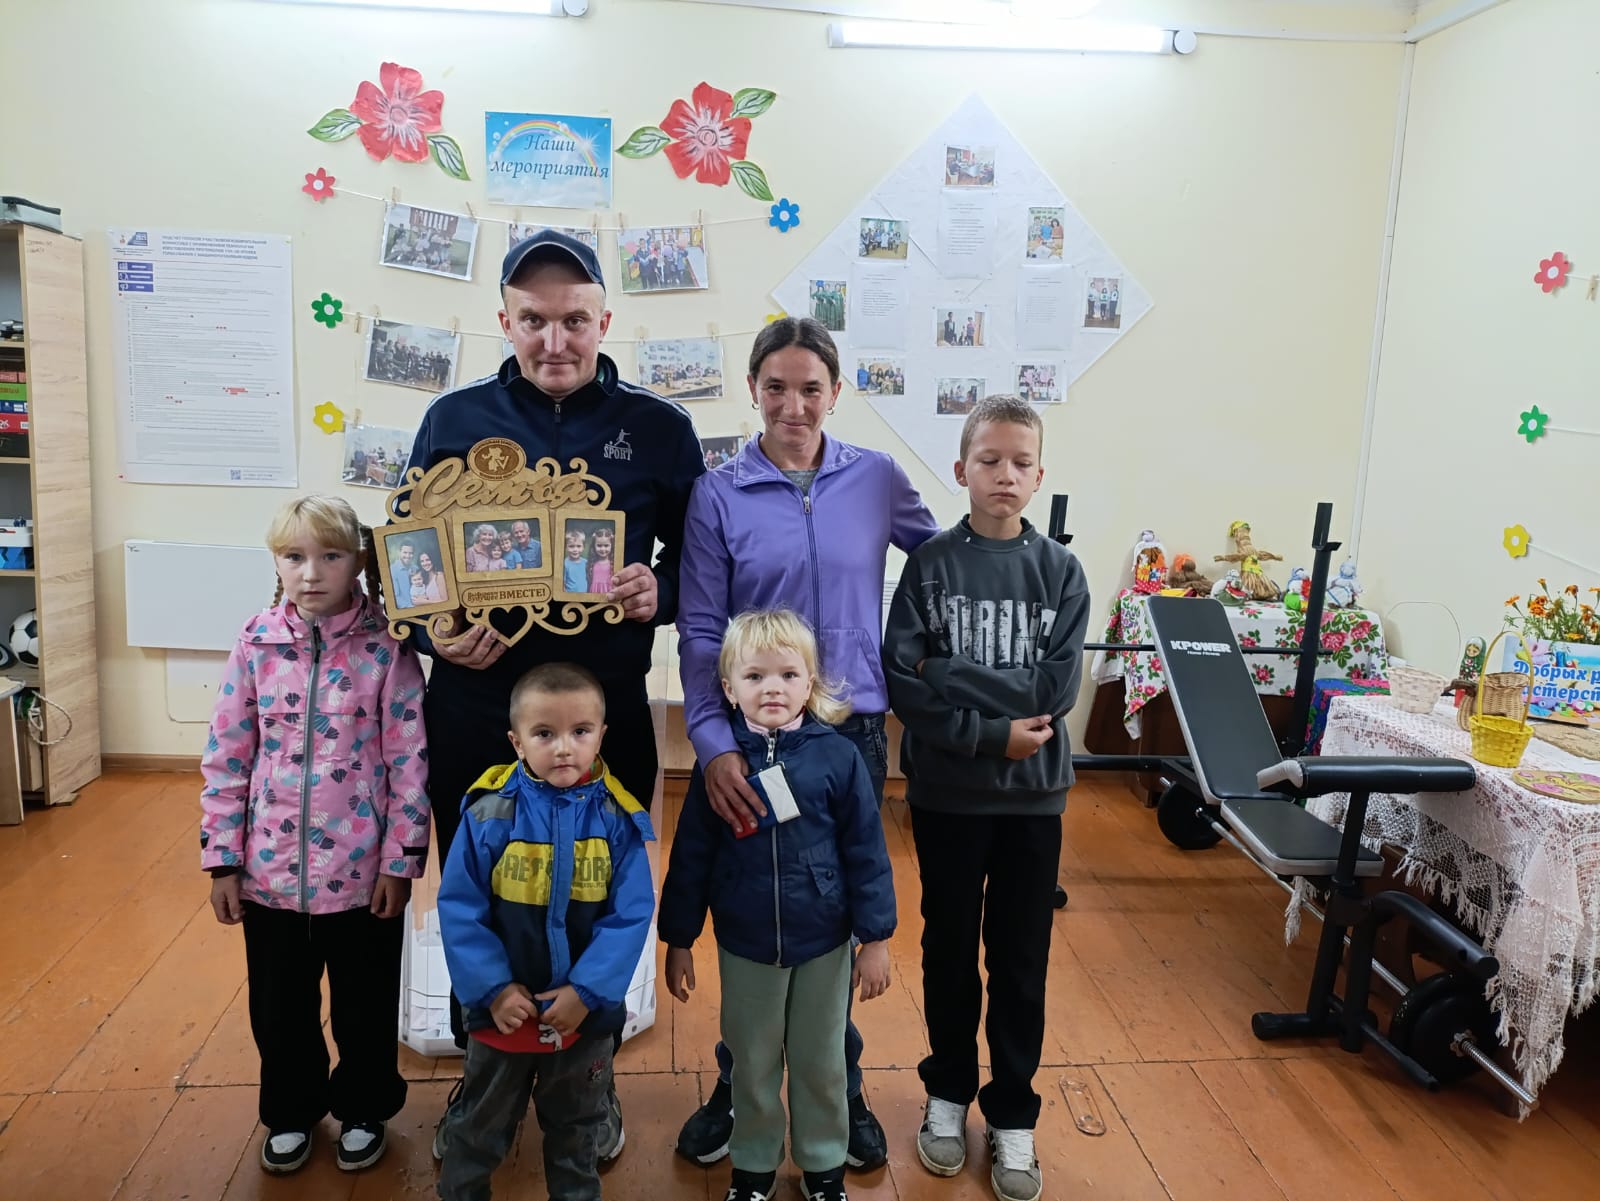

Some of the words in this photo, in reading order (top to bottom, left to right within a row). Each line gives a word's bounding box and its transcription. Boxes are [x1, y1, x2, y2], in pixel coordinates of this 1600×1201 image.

[524, 134, 576, 152] Наши
[490, 160, 609, 180] мероприятия
[604, 443, 633, 461] SPORT
[500, 588, 546, 600] ВМЕСТЕ!
[1170, 640, 1232, 654] KPOWER
